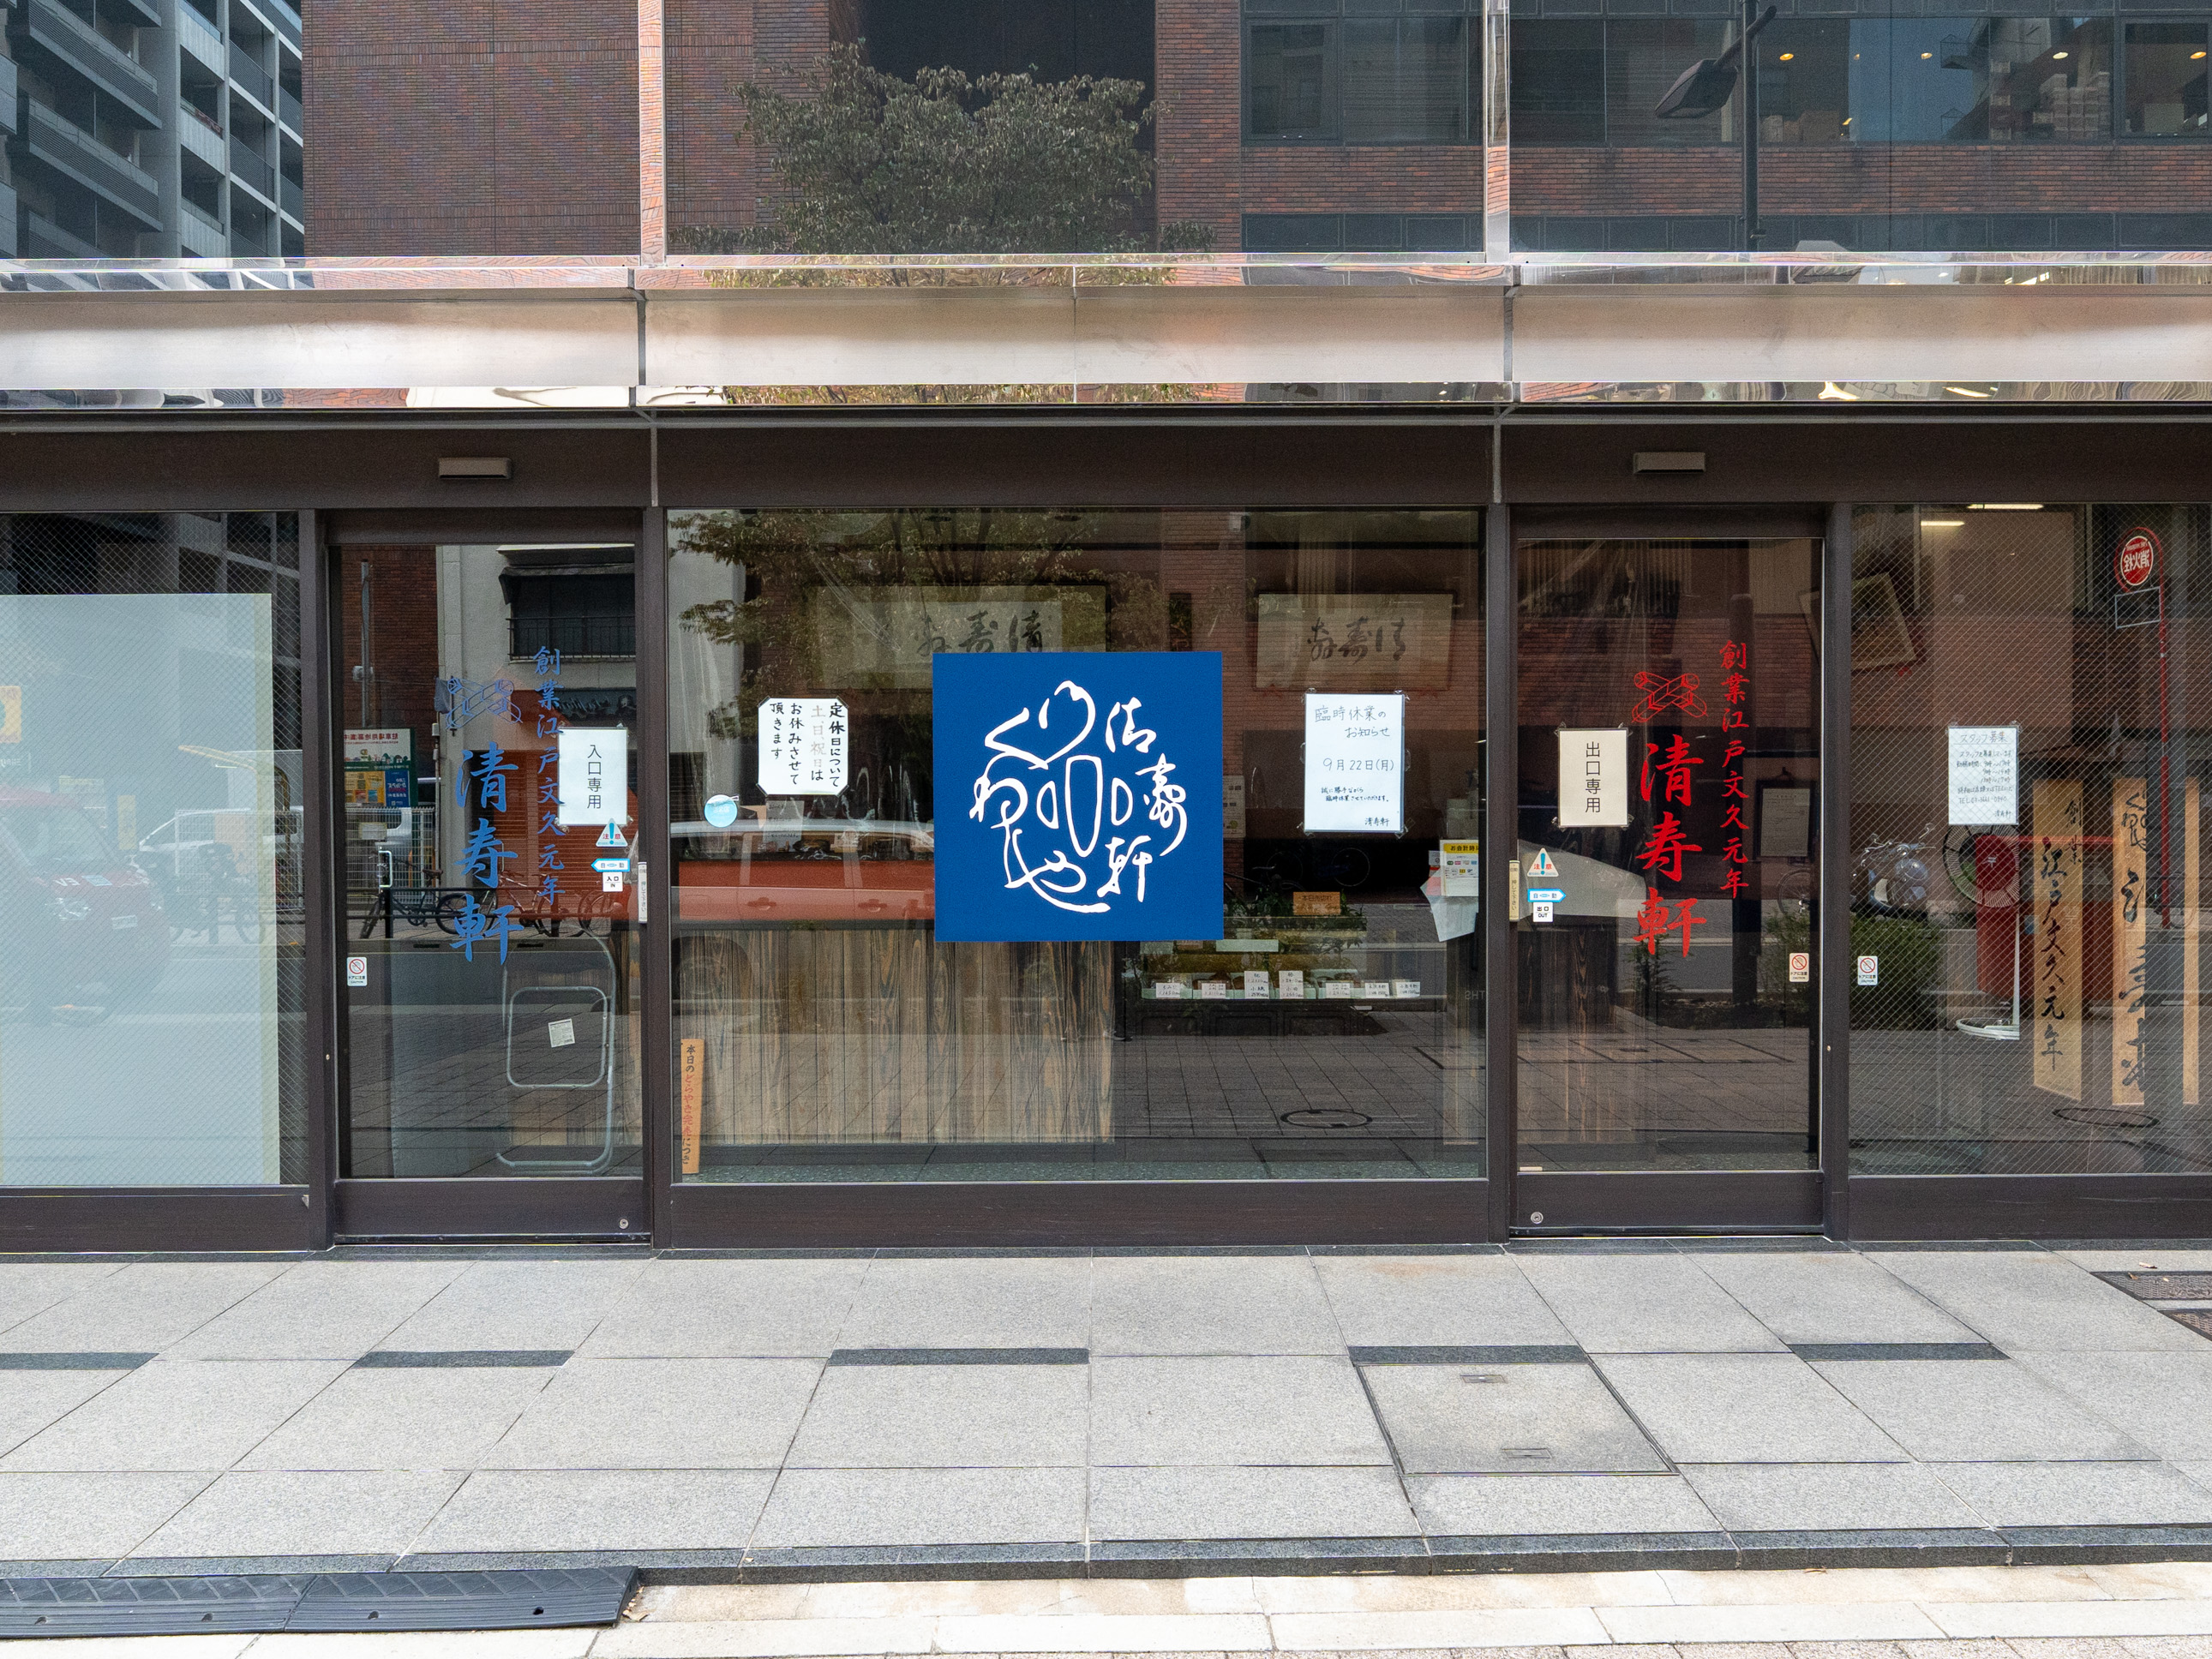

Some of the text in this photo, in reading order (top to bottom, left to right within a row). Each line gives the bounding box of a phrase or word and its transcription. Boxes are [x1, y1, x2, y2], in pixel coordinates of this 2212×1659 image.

[770, 703, 784, 759] 頂きます
[788, 703, 805, 785] お休みさせて
[829, 703, 846, 788] 定休日について
[1315, 705, 1387, 722] 臨時休業の
[1345, 727, 1390, 738] お知らせ
[531, 646, 566, 905] 創業江戸文久元年
[587, 744, 602, 809] 入口専用
[1586, 741, 1601, 813] 出口専用
[1719, 640, 1750, 899] 創業江戸文久元年
[450, 741, 525, 966] 清寿軒
[1364, 817, 1390, 827] 清寿軒
[1633, 734, 1707, 958] 清寿軒
